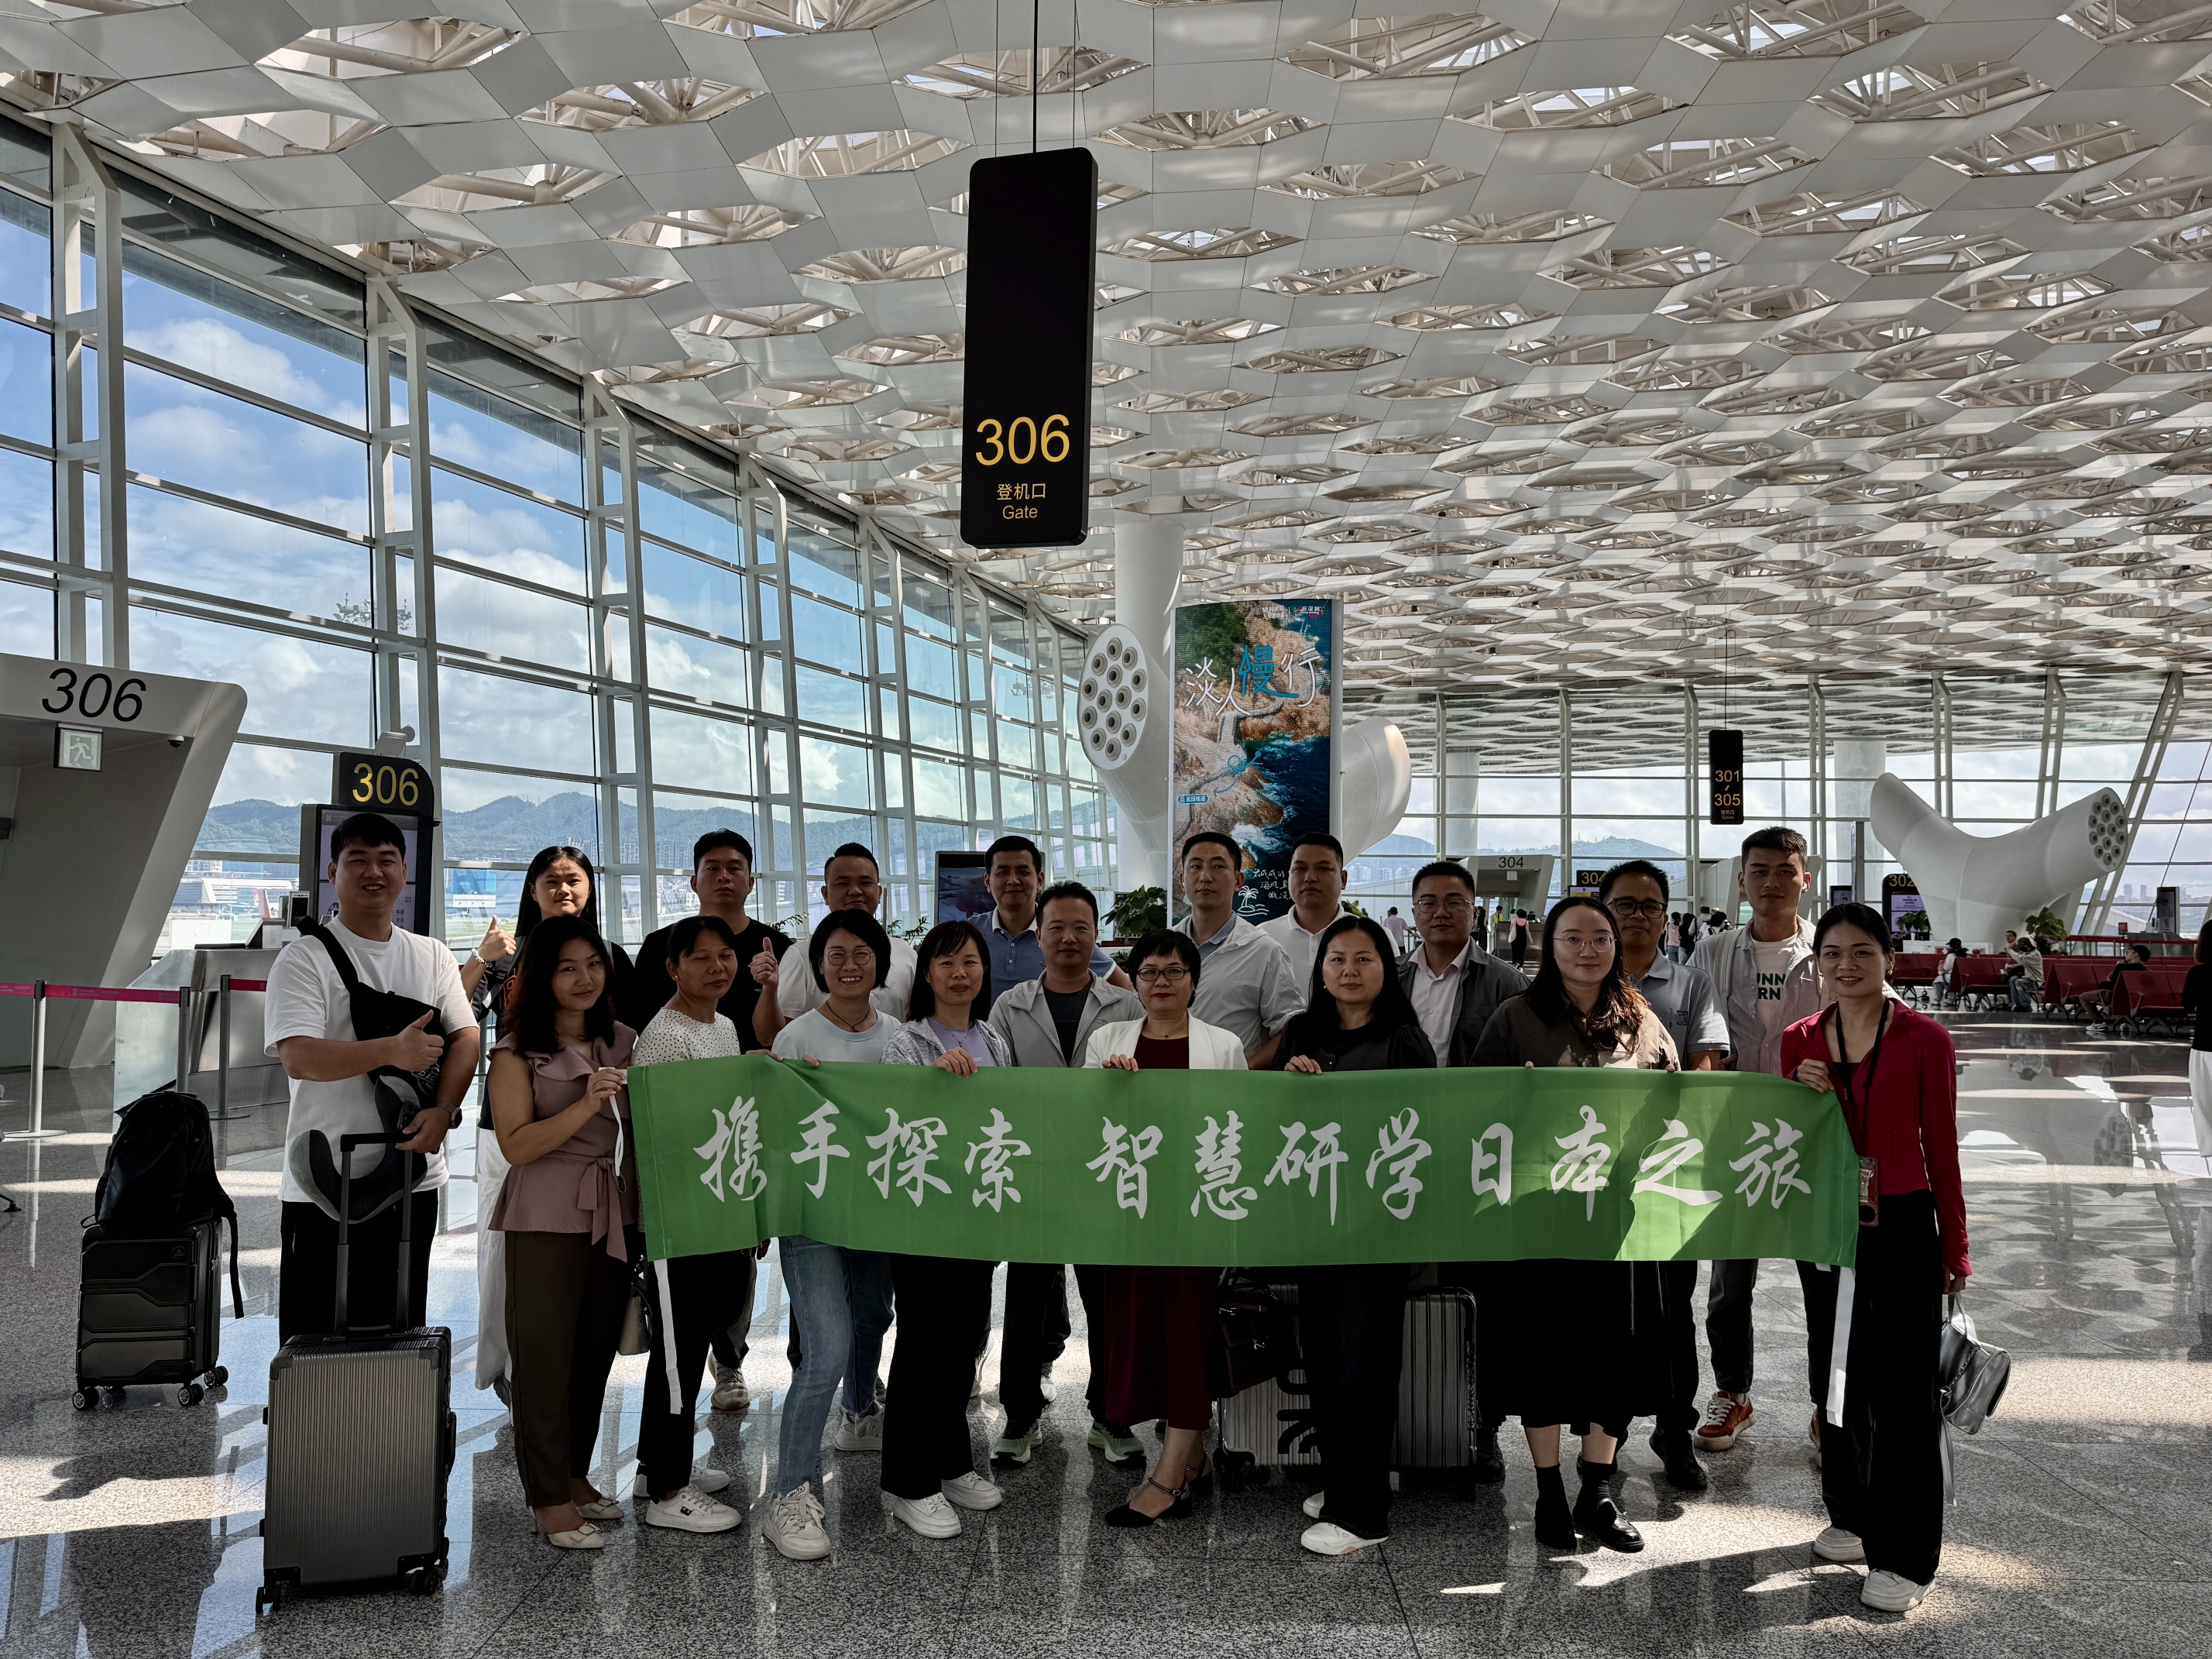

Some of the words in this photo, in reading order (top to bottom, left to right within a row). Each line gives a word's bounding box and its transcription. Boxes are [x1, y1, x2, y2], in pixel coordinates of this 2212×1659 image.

[975, 414, 1070, 466] 306
[996, 483, 1046, 501] 登机口
[1002, 505, 1039, 520] Gate
[41, 668, 147, 723] 306
[352, 762, 419, 806] 306
[1715, 770, 1740, 782] 301
[1714, 793, 1741, 806] 305
[1498, 856, 1524, 868] 304
[1268, 891, 1293, 900] 做淡
[693, 1096, 1032, 1213] 携手探索
[1086, 1104, 1812, 1226] 智慧研学日本之旅
